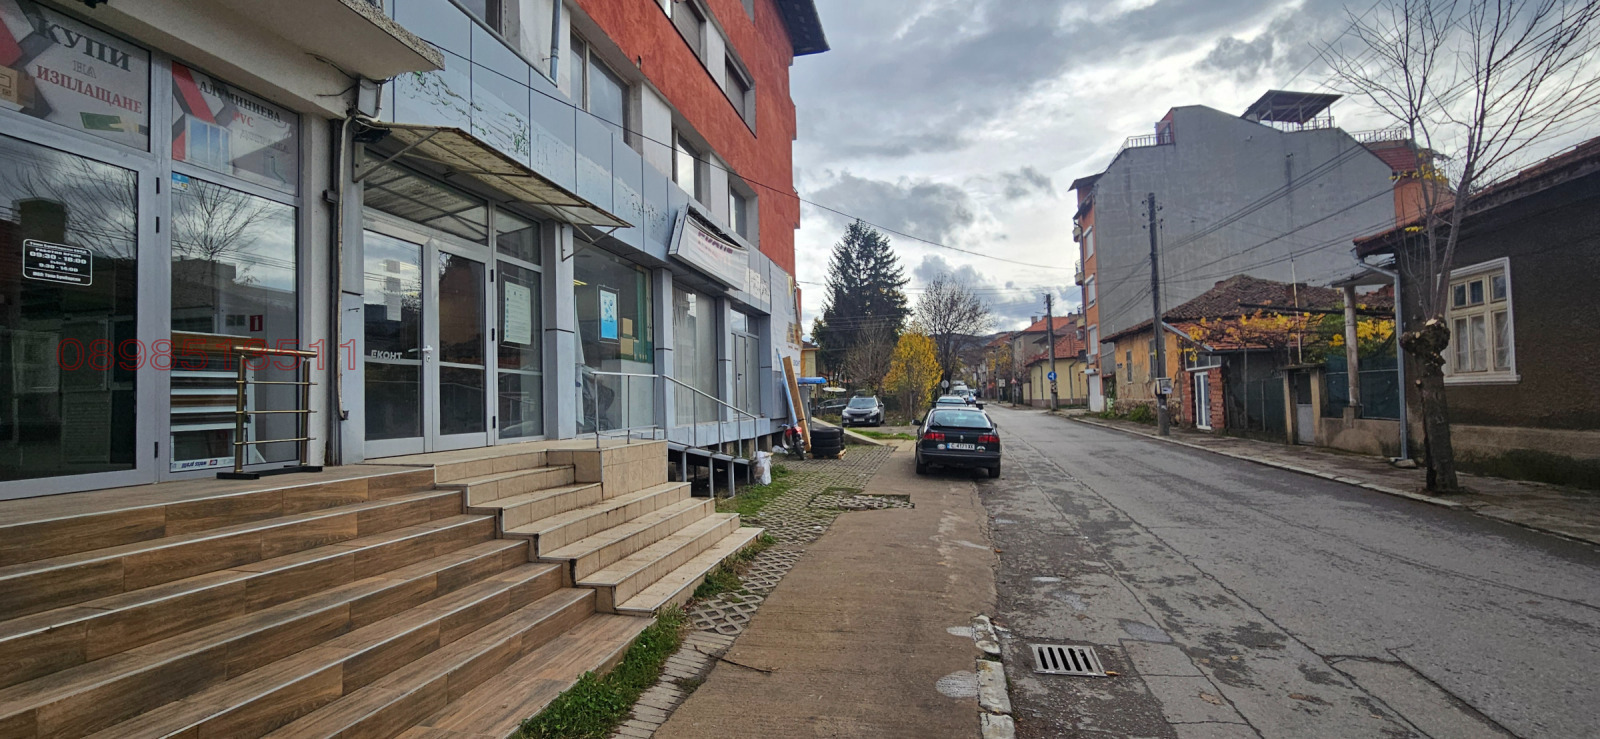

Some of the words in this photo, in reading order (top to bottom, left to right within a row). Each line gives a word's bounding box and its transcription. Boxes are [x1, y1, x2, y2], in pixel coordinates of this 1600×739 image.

[36, 18, 131, 72] КУПИ
[72, 60, 97, 79] НА
[36, 65, 143, 114] ИЗПЛАЩАНЕ
[231, 109, 254, 128] PVC
[371, 350, 403, 361] ЕКОНТ
